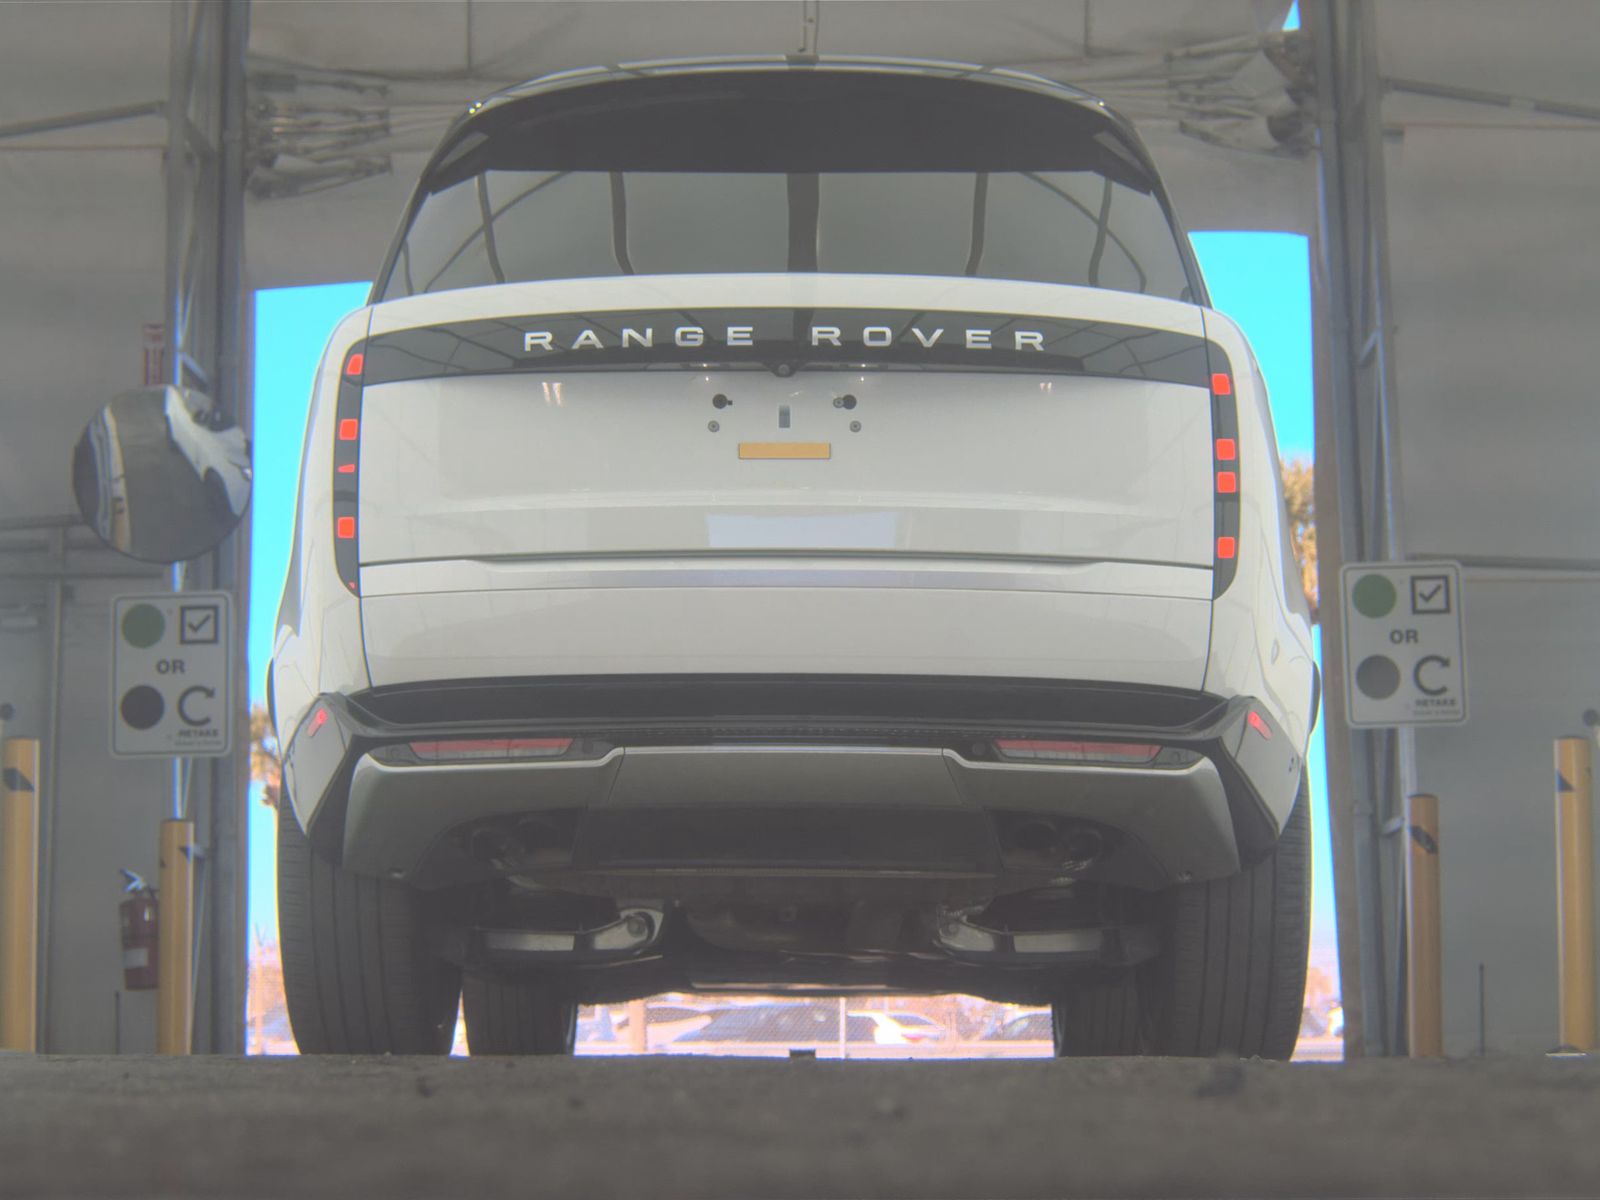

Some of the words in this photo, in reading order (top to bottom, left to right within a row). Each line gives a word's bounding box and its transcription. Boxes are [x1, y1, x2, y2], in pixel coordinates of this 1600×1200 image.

[523, 326, 754, 352] RANGE
[811, 326, 1046, 352] ROVER
[1389, 629, 1418, 644] OR
[156, 658, 185, 674] OR
